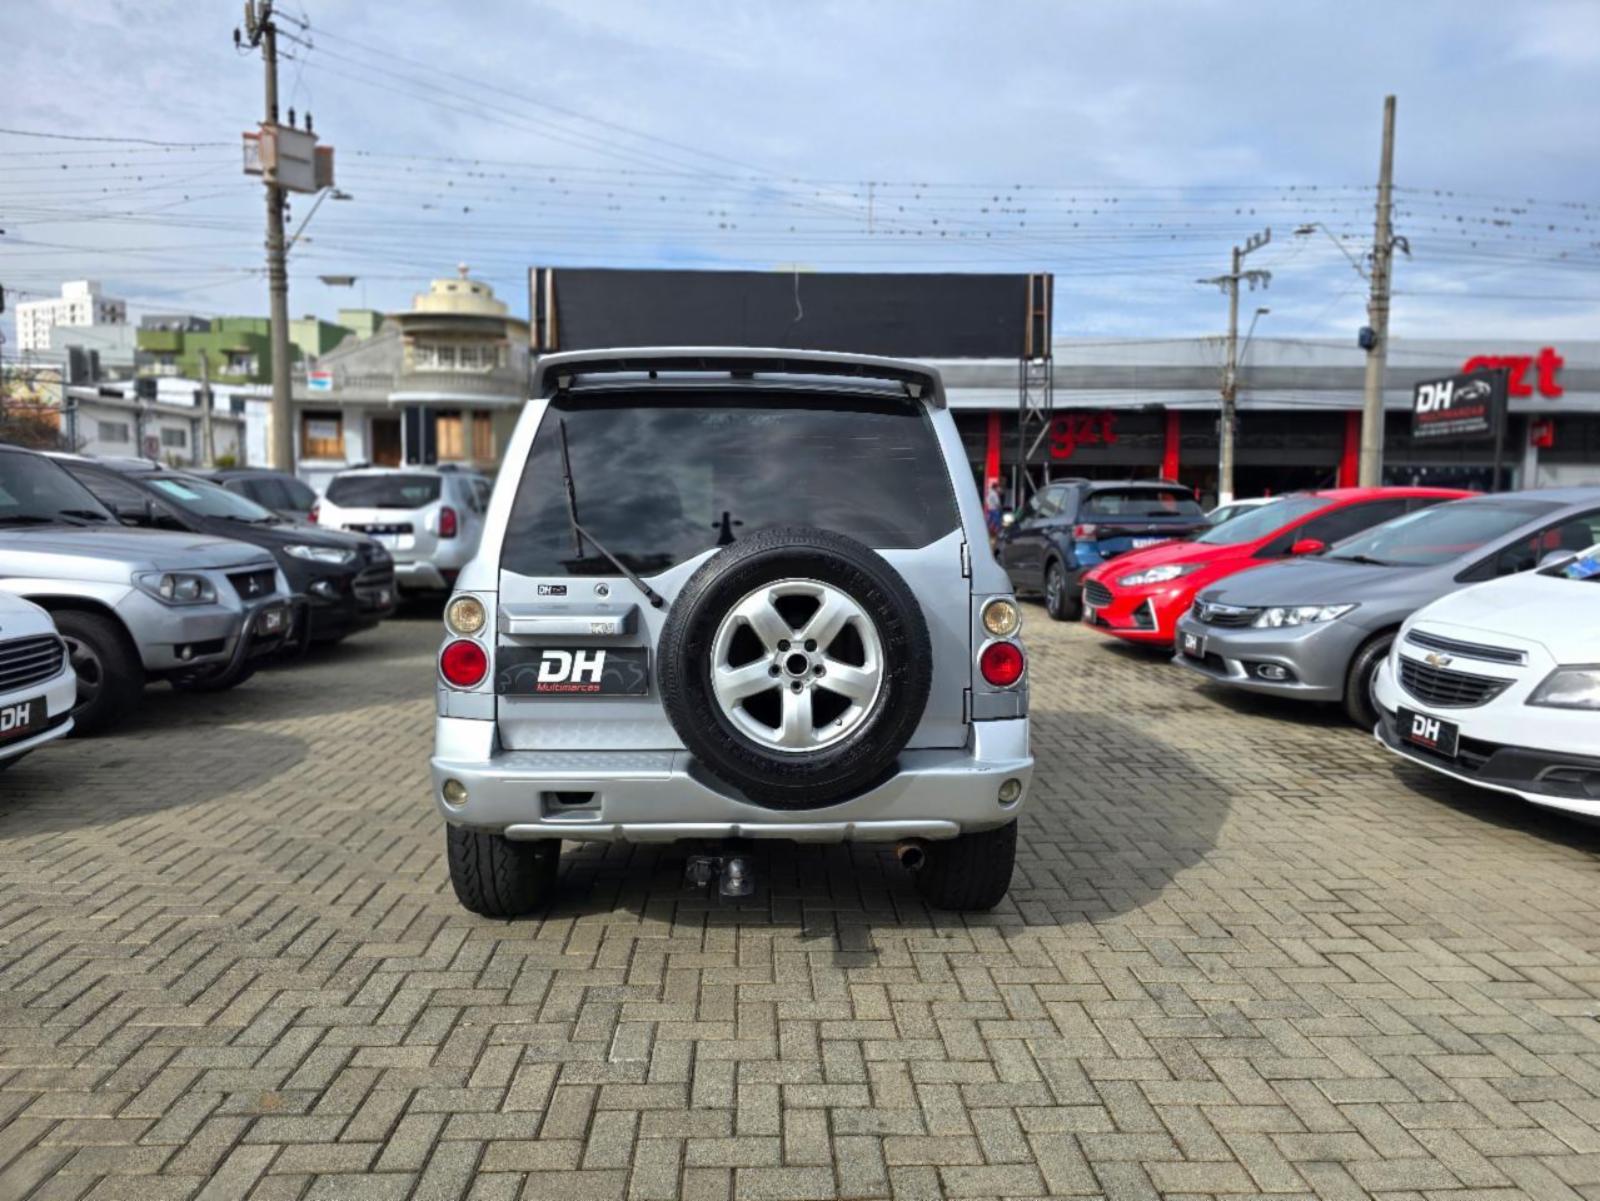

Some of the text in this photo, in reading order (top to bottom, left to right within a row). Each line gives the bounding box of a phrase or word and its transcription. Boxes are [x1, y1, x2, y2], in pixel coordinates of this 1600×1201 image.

[1416, 381, 1454, 413] DH
[1050, 410, 1118, 460] gzt
[537, 650, 606, 682] DH
[536, 683, 600, 692] Multimarcas
[0, 703, 31, 731] DH
[1412, 713, 1440, 742] DH
